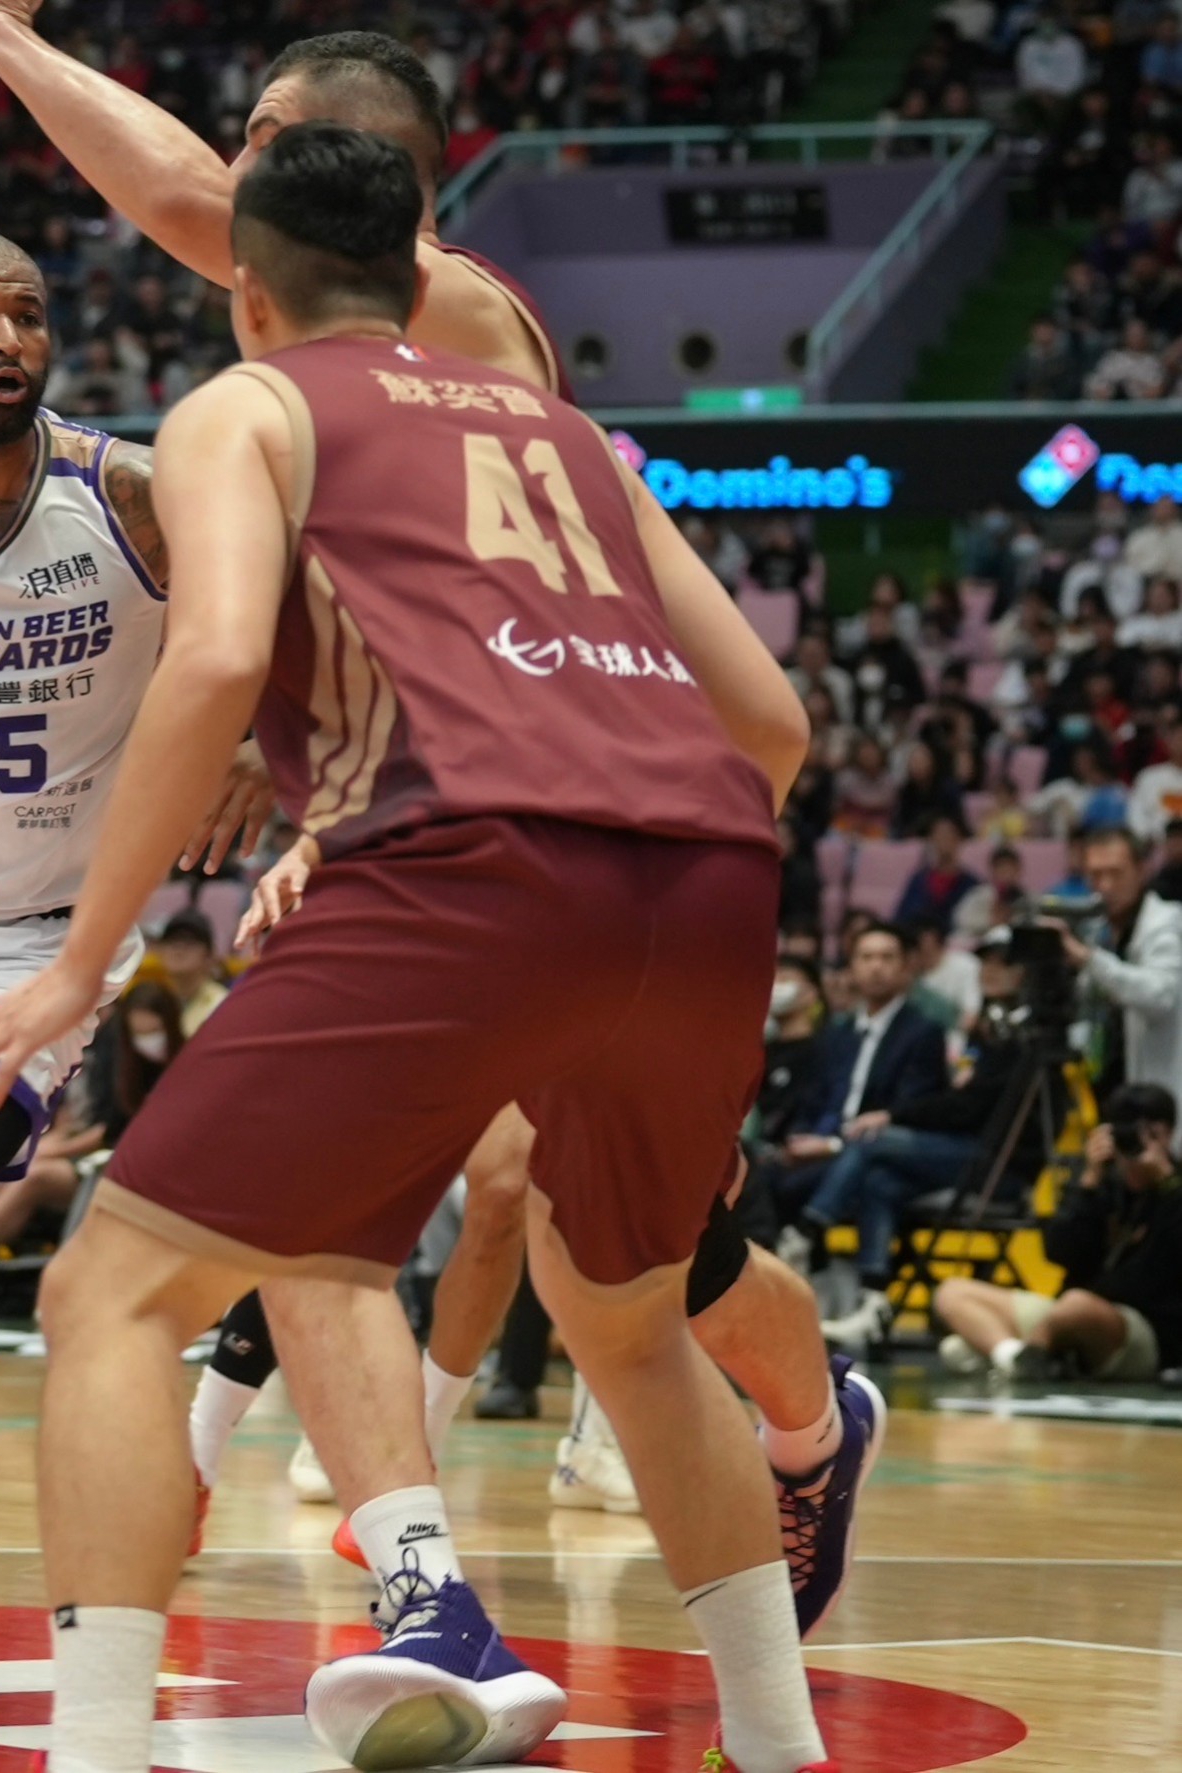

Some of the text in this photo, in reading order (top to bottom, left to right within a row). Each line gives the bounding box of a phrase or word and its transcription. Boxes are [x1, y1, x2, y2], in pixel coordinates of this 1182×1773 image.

[644, 455, 892, 510] Domino's
[463, 433, 623, 597] 41
[19, 552, 99, 600] 浪直播
[59, 576, 100, 594] LIVE
[23, 600, 109, 639] BEER
[14, 803, 77, 817] CARPOST
[405, 1523, 440, 1534] NIKE
